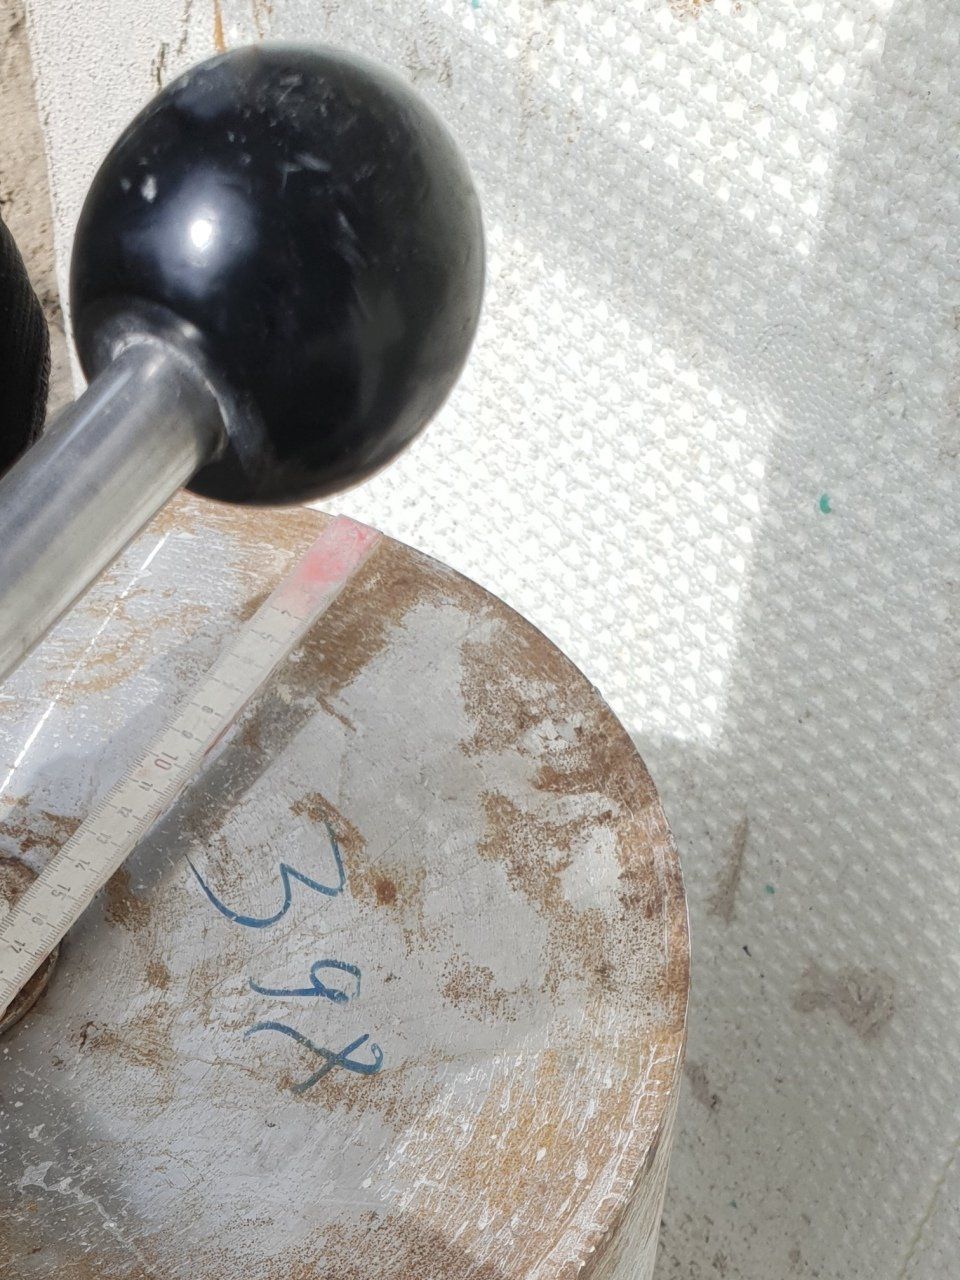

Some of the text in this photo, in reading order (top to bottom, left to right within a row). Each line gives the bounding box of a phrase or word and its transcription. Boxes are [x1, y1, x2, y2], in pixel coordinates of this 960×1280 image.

[154, 751, 179, 772] 10
[138, 781, 153, 792] 11
[118, 806, 134, 818] 12
[75, 860, 91, 871] 14
[51, 884, 71, 900] 15
[10, 939, 26, 954] 17
